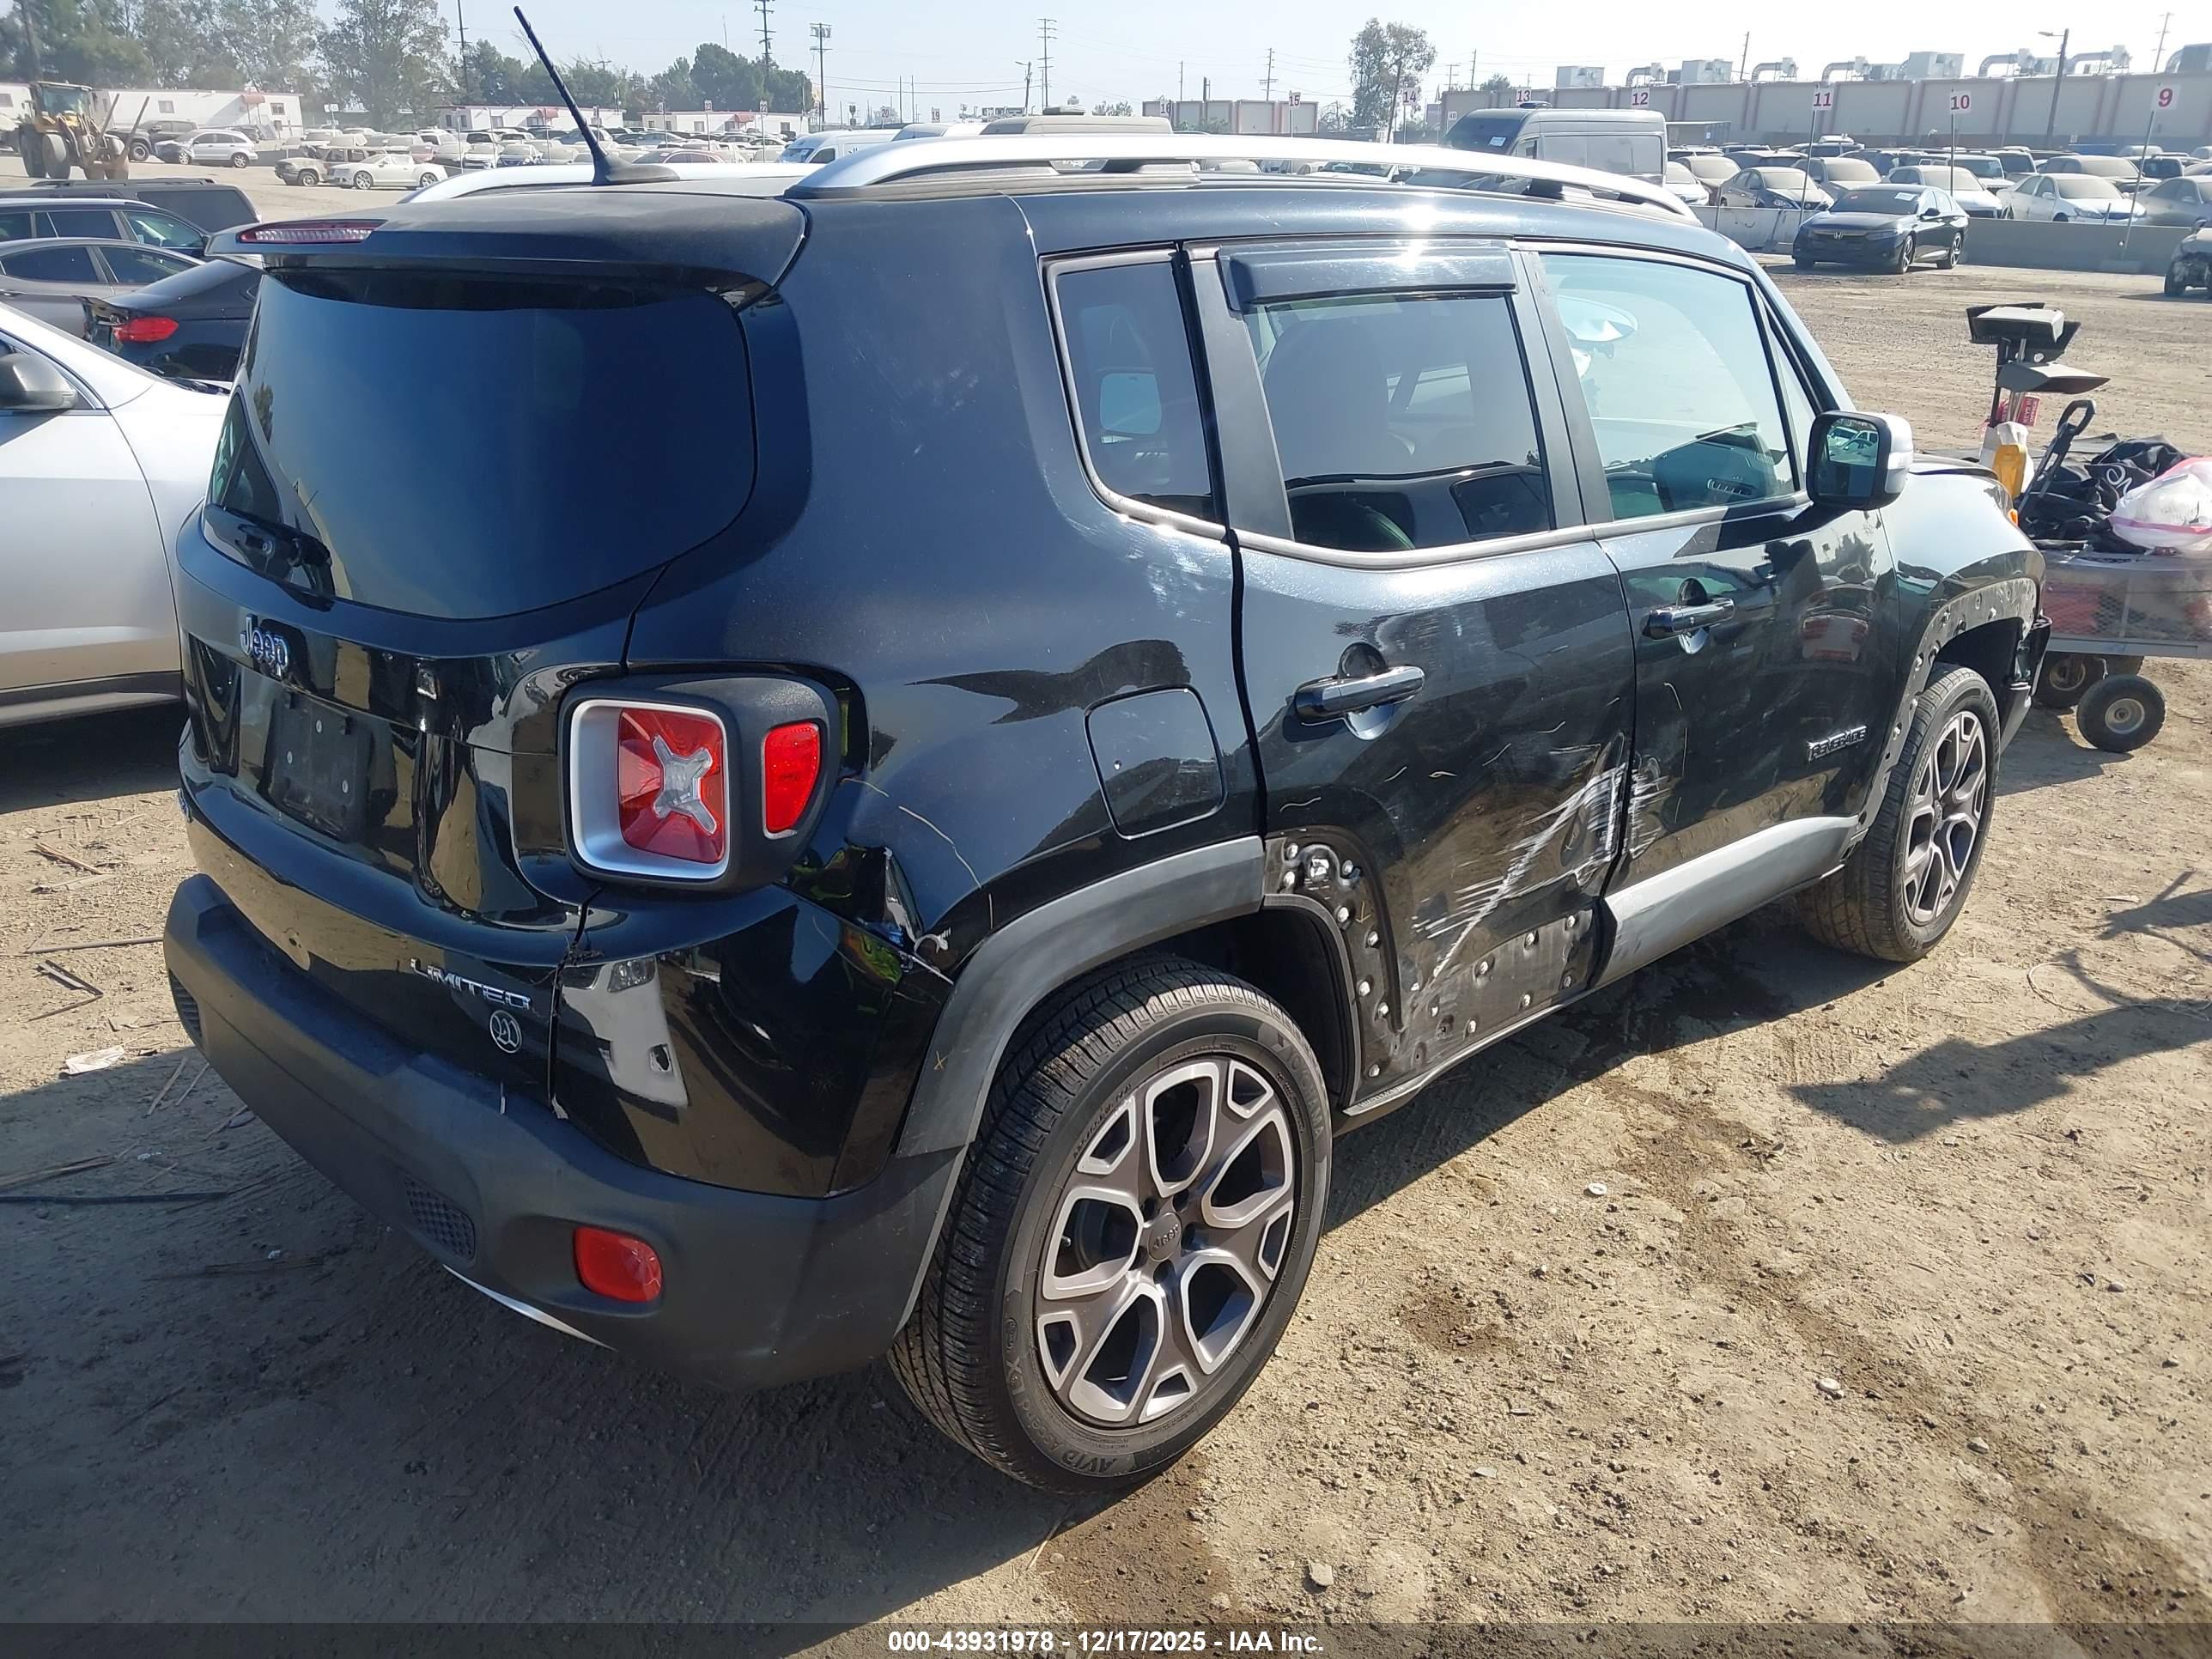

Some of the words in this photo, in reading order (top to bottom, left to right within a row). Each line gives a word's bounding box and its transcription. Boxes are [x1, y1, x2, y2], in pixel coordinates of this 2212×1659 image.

[1289, 94, 1301, 106] 15
[1403, 90, 1417, 103] 14
[1517, 90, 1531, 102] 13
[1632, 92, 1649, 106] 12
[1813, 92, 1832, 107] 11
[1950, 94, 1971, 111] 10
[2158, 88, 2173, 107] 9
[881, 108, 890, 118] 20
[931, 111, 941, 121] 19
[240, 613, 289, 677] Jeep
[1807, 726, 1868, 763] RENEGADE
[410, 957, 532, 1012] LIMITED
[1153, 1224, 1180, 1249] Jeep
[1005, 1356, 1026, 1396] LX
[1060, 1451, 1118, 1474] AVID
